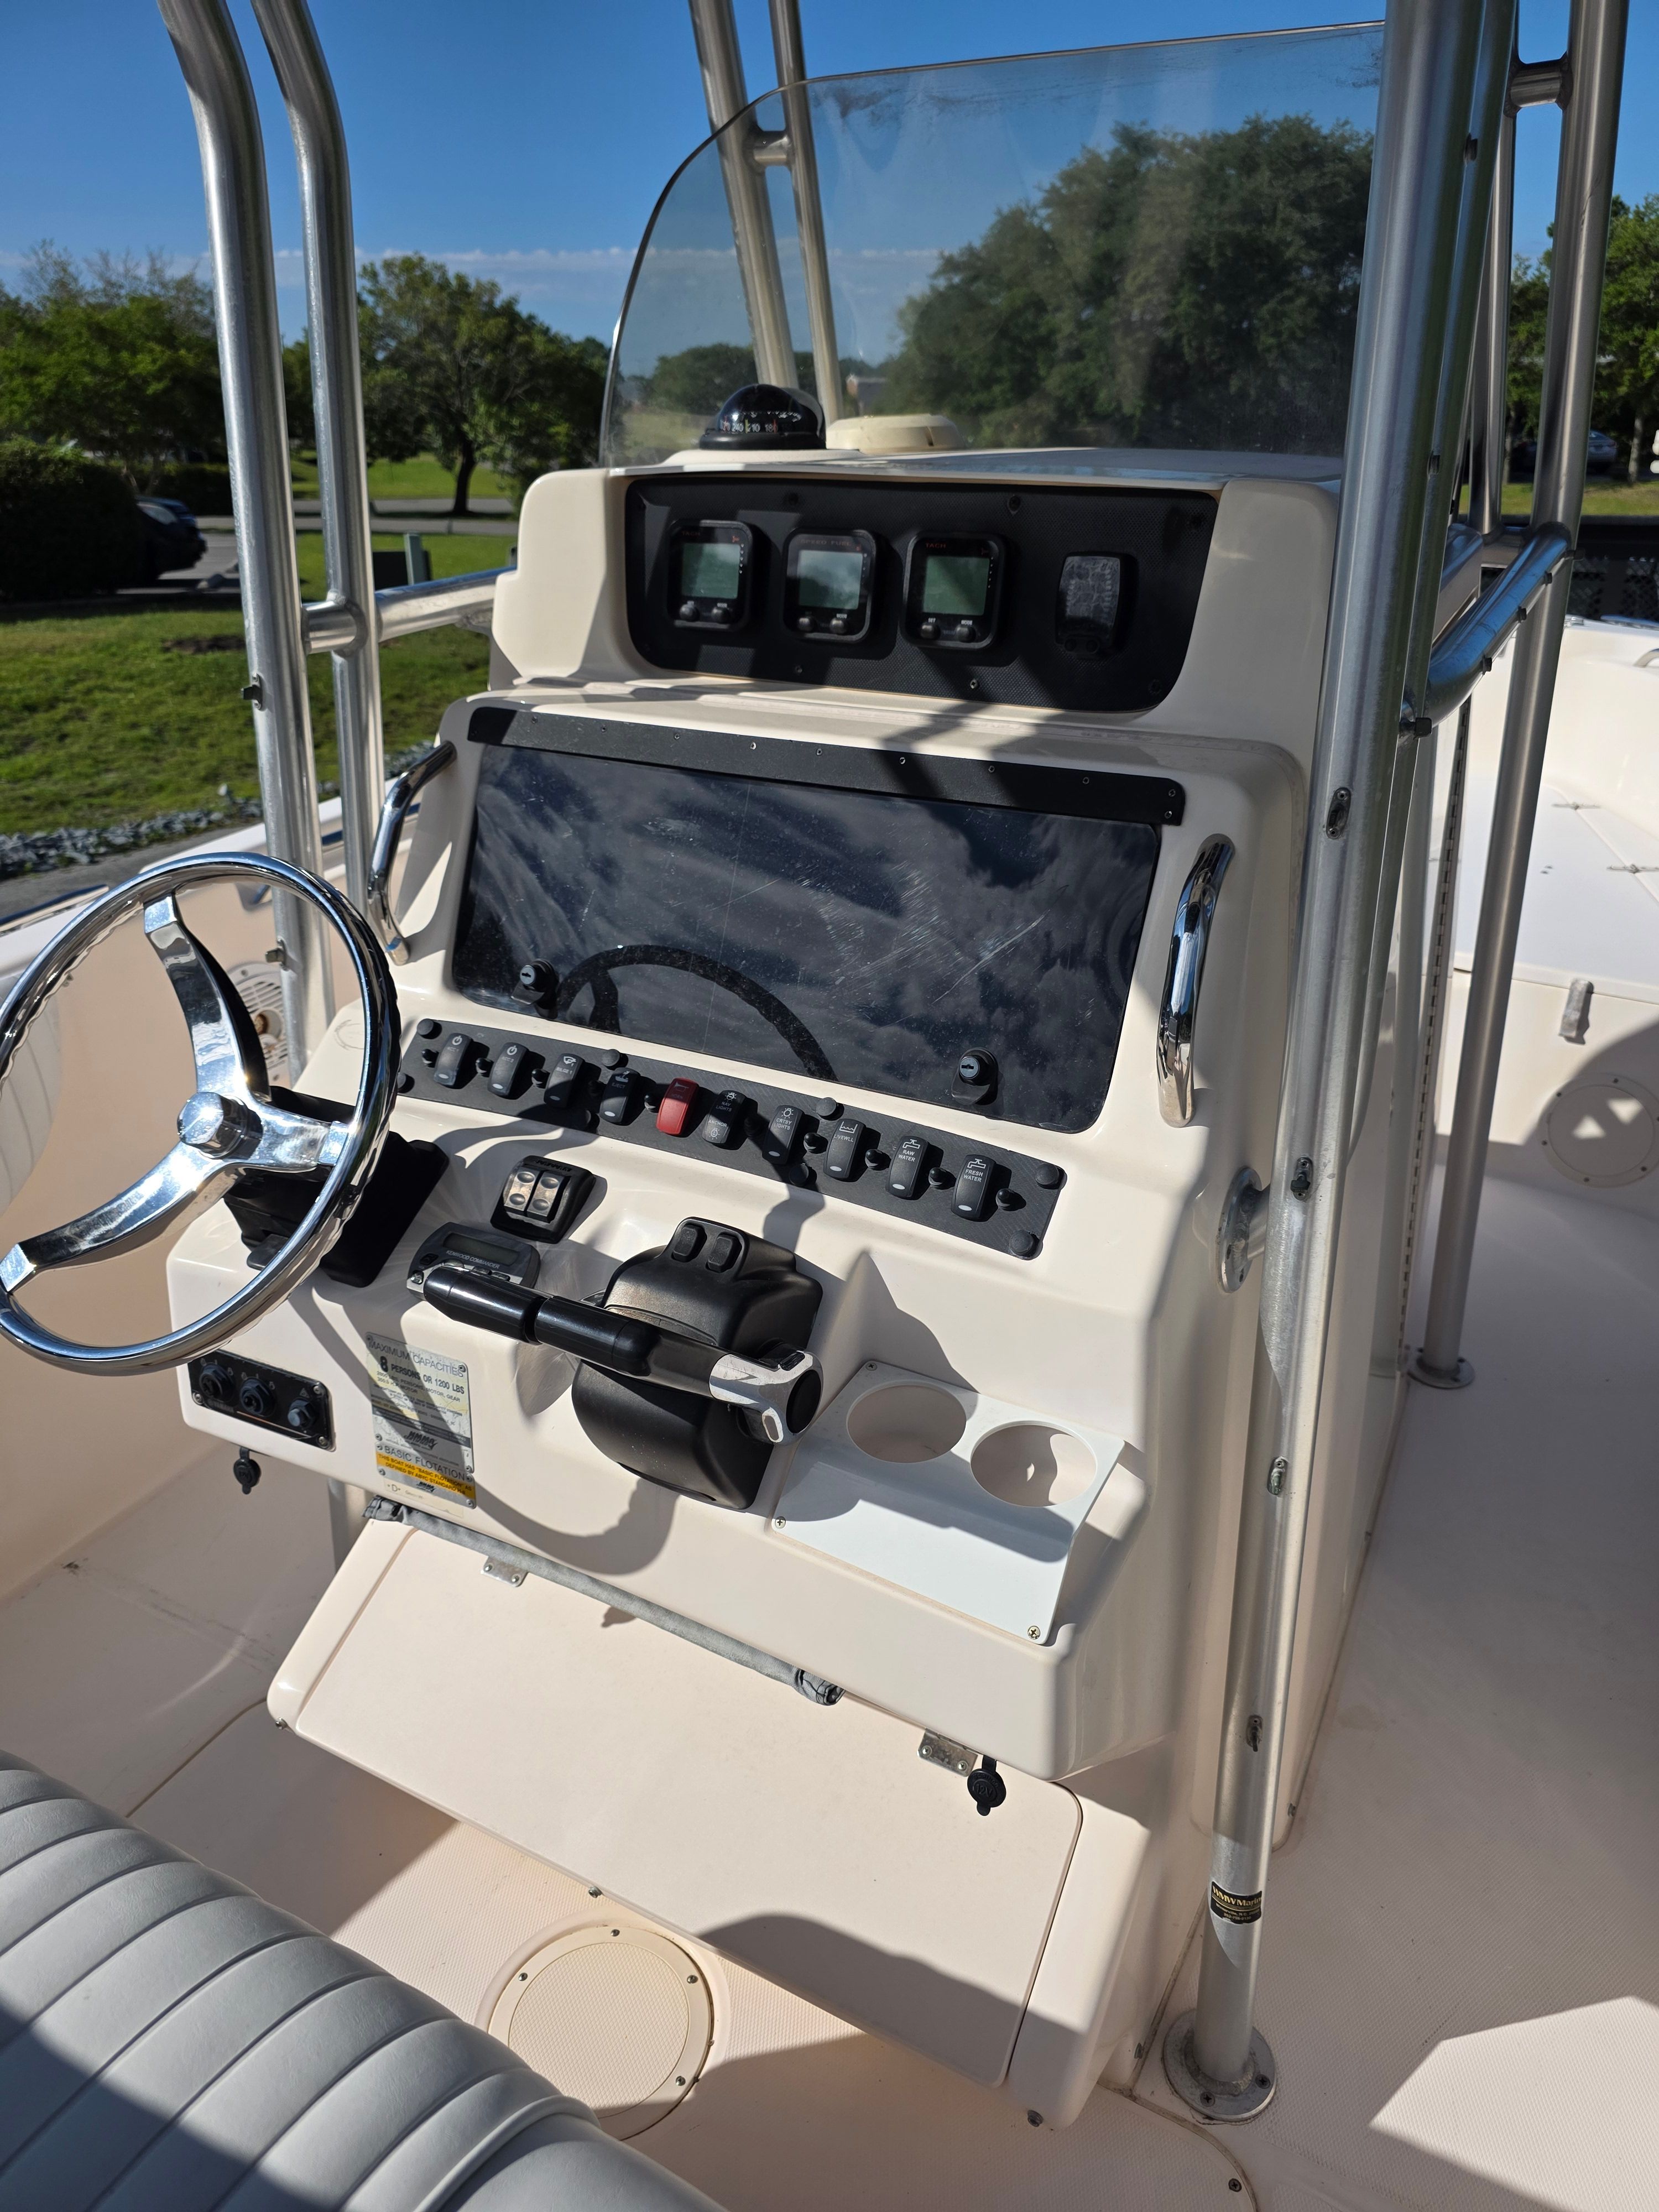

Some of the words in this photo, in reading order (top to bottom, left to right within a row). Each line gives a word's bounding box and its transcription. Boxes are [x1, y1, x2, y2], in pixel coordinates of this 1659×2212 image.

[707, 1119, 728, 1128] ANCHOR
[833, 1134, 854, 1142] LIVEWLL
[898, 1154, 916, 1162] WATER
[963, 1174, 982, 1182] WATER
[965, 1169, 984, 1177] FRESH
[446, 1250, 469, 1260] KENWOOD
[469, 1256, 500, 1269] COMMANDER
[369, 1341, 410, 1360] MAXIMUM
[413, 1354, 464, 1378] CAPACITIES
[380, 1355, 388, 1373] 8
[390, 1364, 421, 1380] PERSONS
[423, 1374, 432, 1384] OR
[435, 1379, 450, 1389] 1200
[452, 1384, 465, 1395] LBS
[446, 1394, 461, 1402] GEAR
[384, 1446, 412, 1462] BASIC
[415, 1457, 465, 1481] FLOTATION
[385, 1462, 406, 1474] DEFINED
[415, 1474, 429, 1482] ABYC
[429, 1478, 457, 1491] STANDARD
[975, 1784, 993, 1797] 12V
